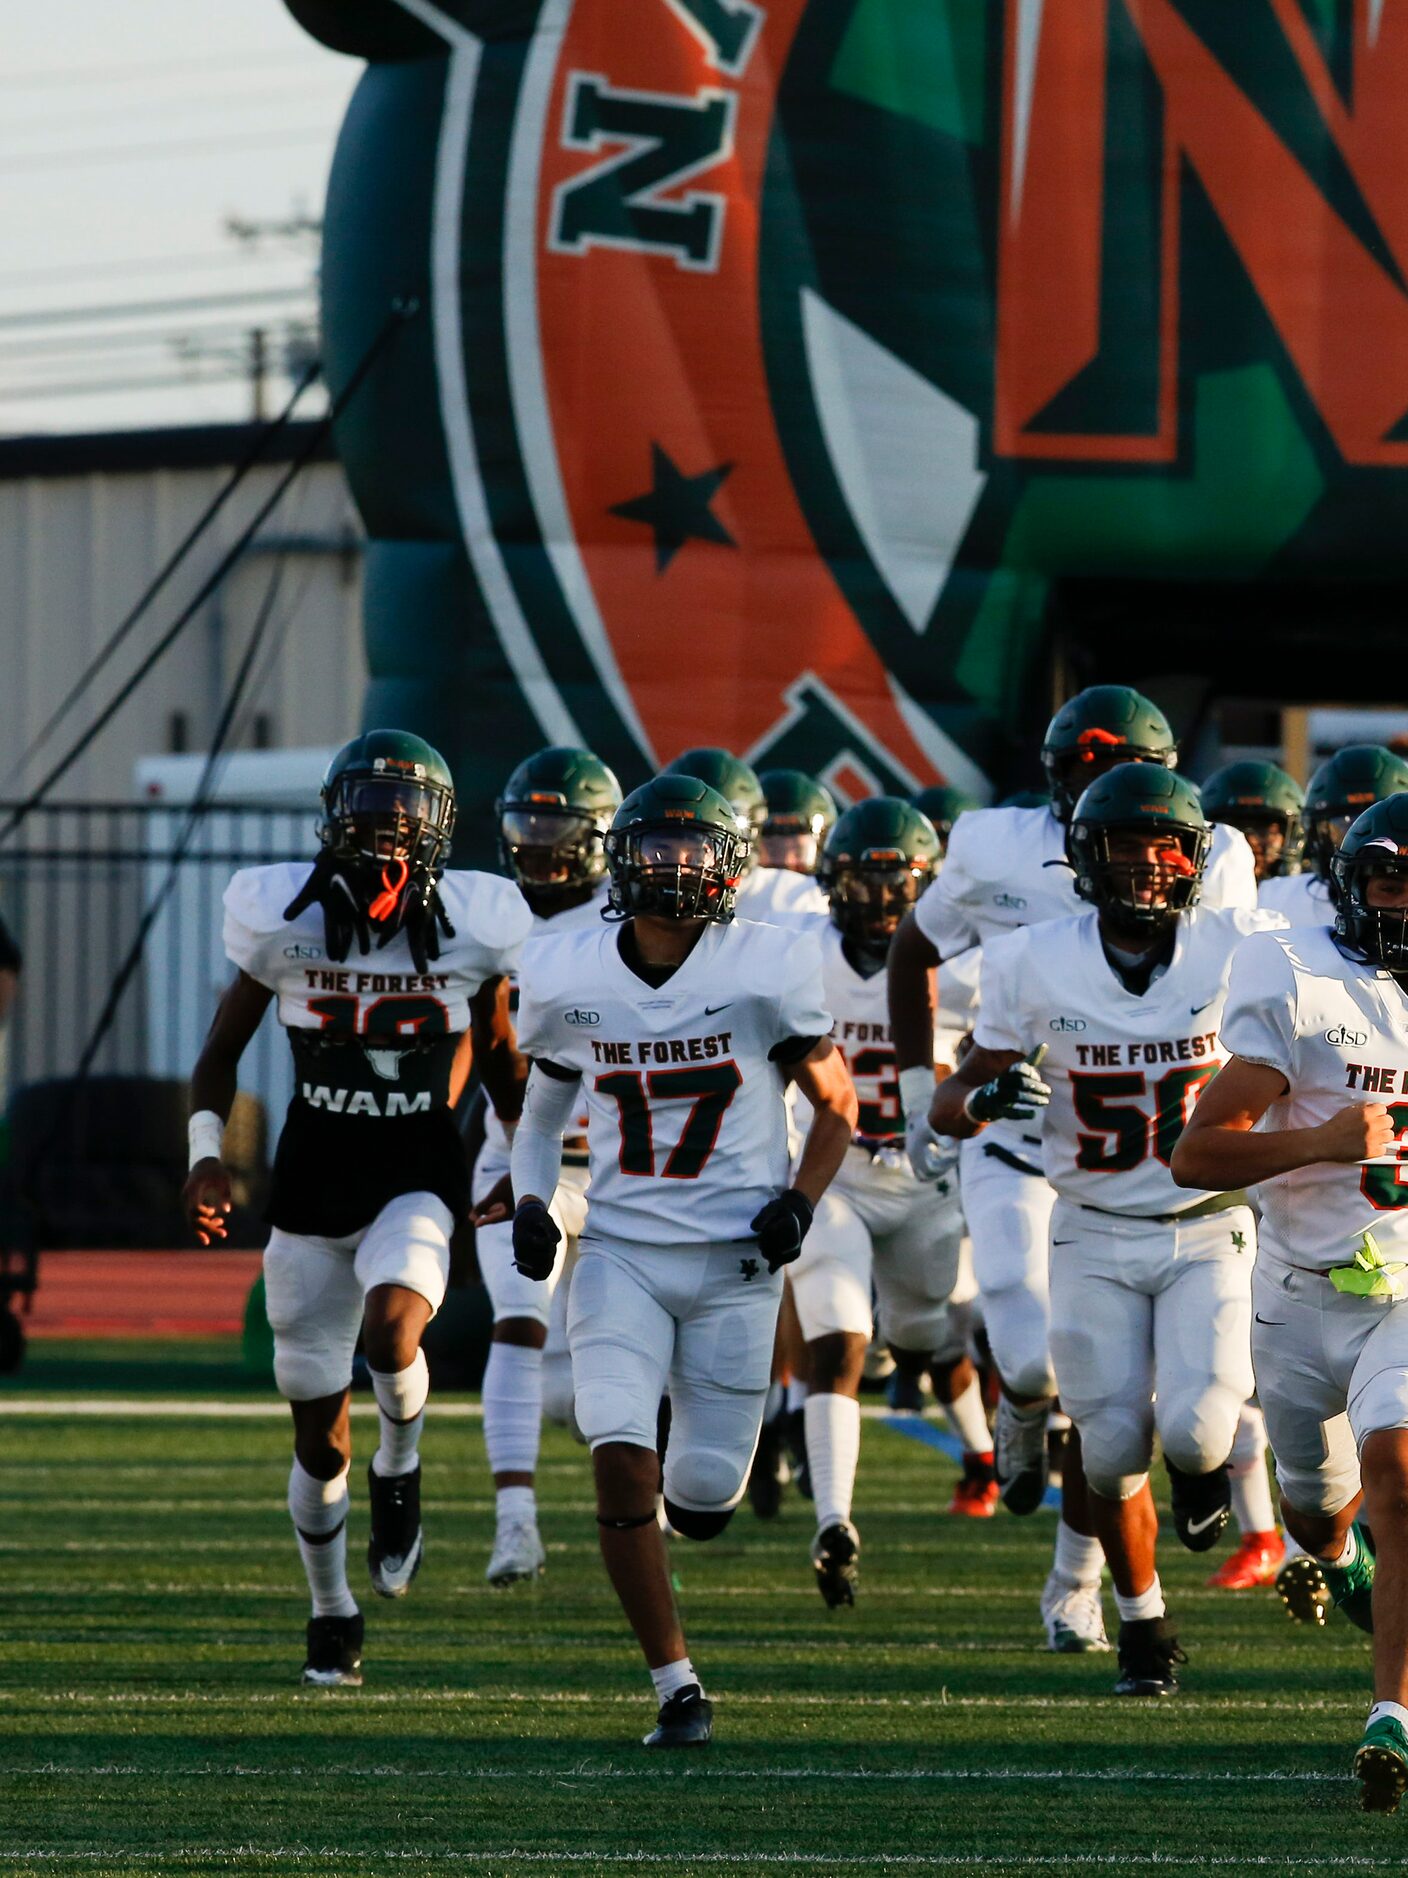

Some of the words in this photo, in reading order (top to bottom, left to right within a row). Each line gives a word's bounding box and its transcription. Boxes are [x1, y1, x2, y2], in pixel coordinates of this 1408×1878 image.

[305, 969, 351, 992] THE
[357, 974, 449, 993] FOREST
[591, 1040, 633, 1064] THE
[638, 1032, 732, 1064] FOREST
[1076, 1045, 1121, 1066] THE
[1128, 1032, 1217, 1065] FOREST
[1346, 1063, 1397, 1094] THE
[303, 1082, 432, 1117] WAM
[594, 1058, 743, 1179] 17
